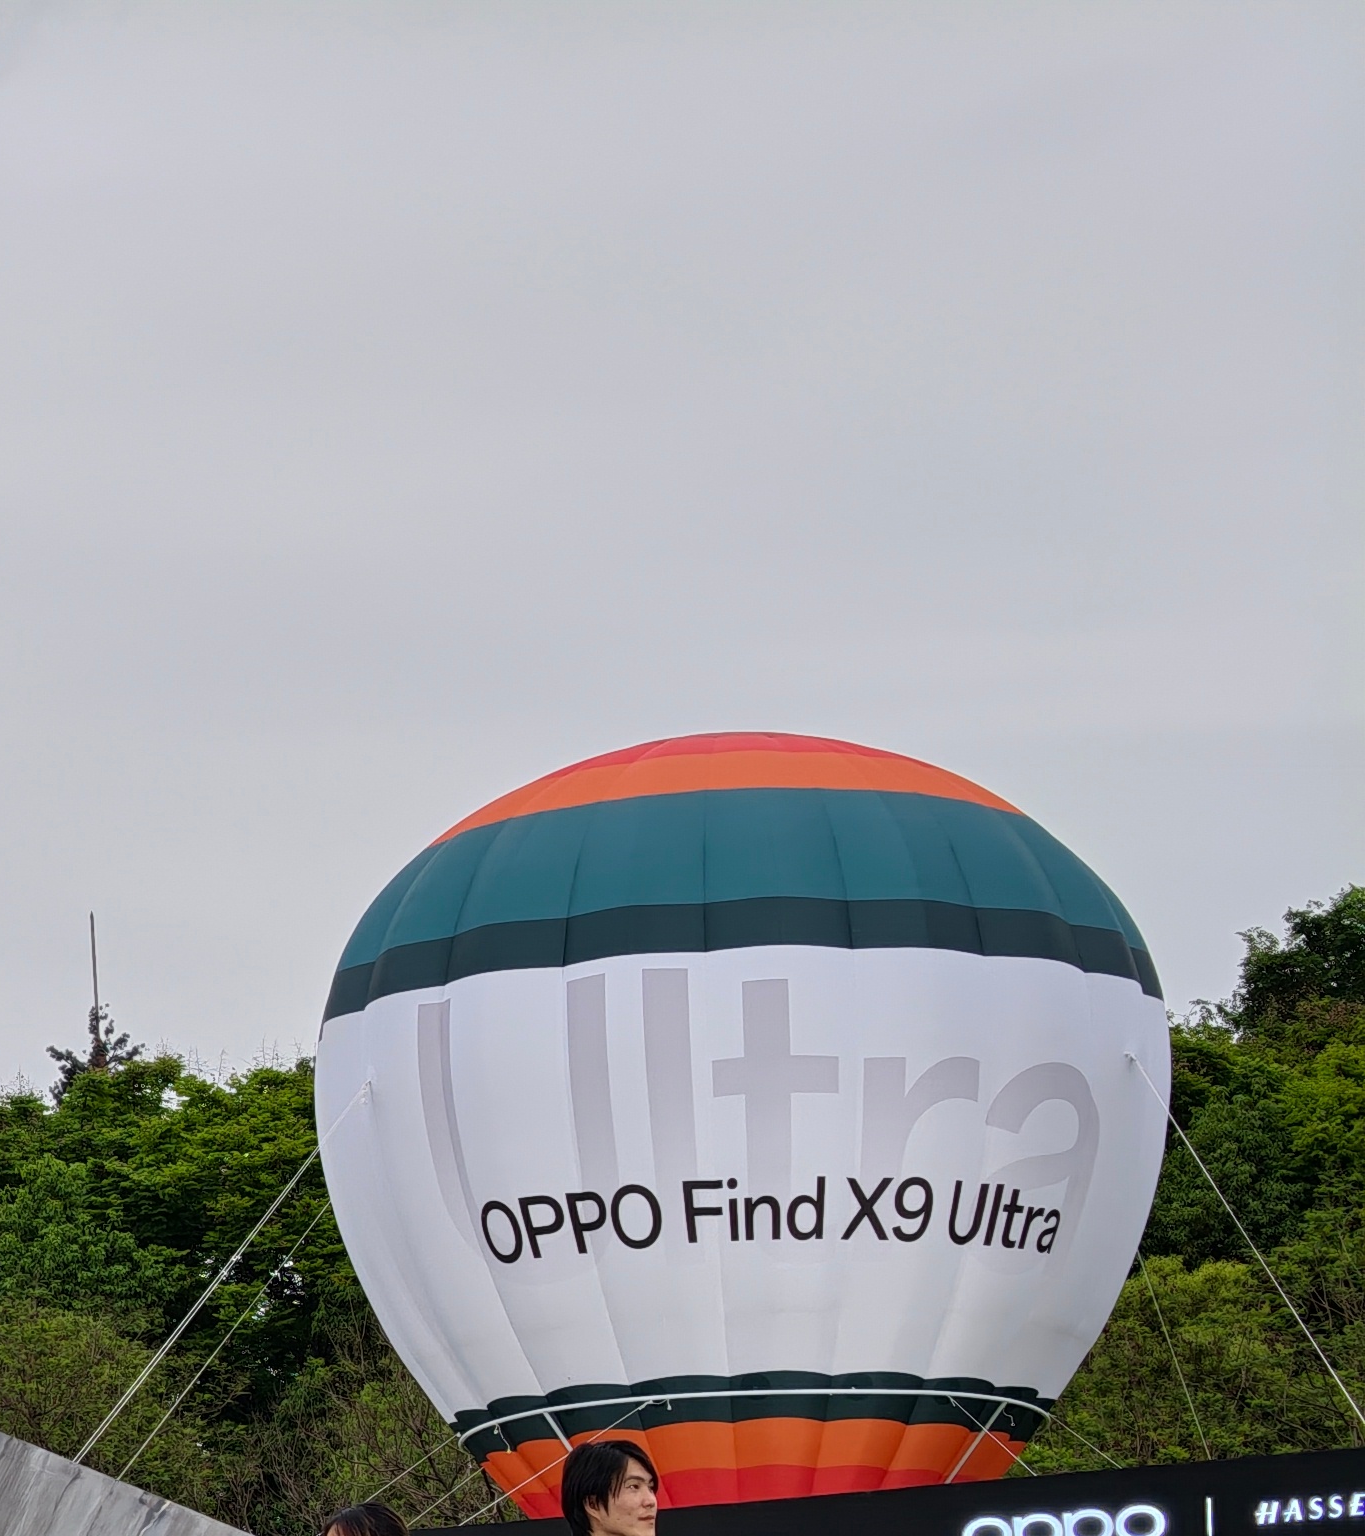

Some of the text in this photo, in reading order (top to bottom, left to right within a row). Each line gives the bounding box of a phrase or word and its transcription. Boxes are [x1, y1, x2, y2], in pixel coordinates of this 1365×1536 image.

[417, 968, 1099, 1275] Ultra
[481, 1176, 1061, 1265] OPPO Find X9 Ultra
